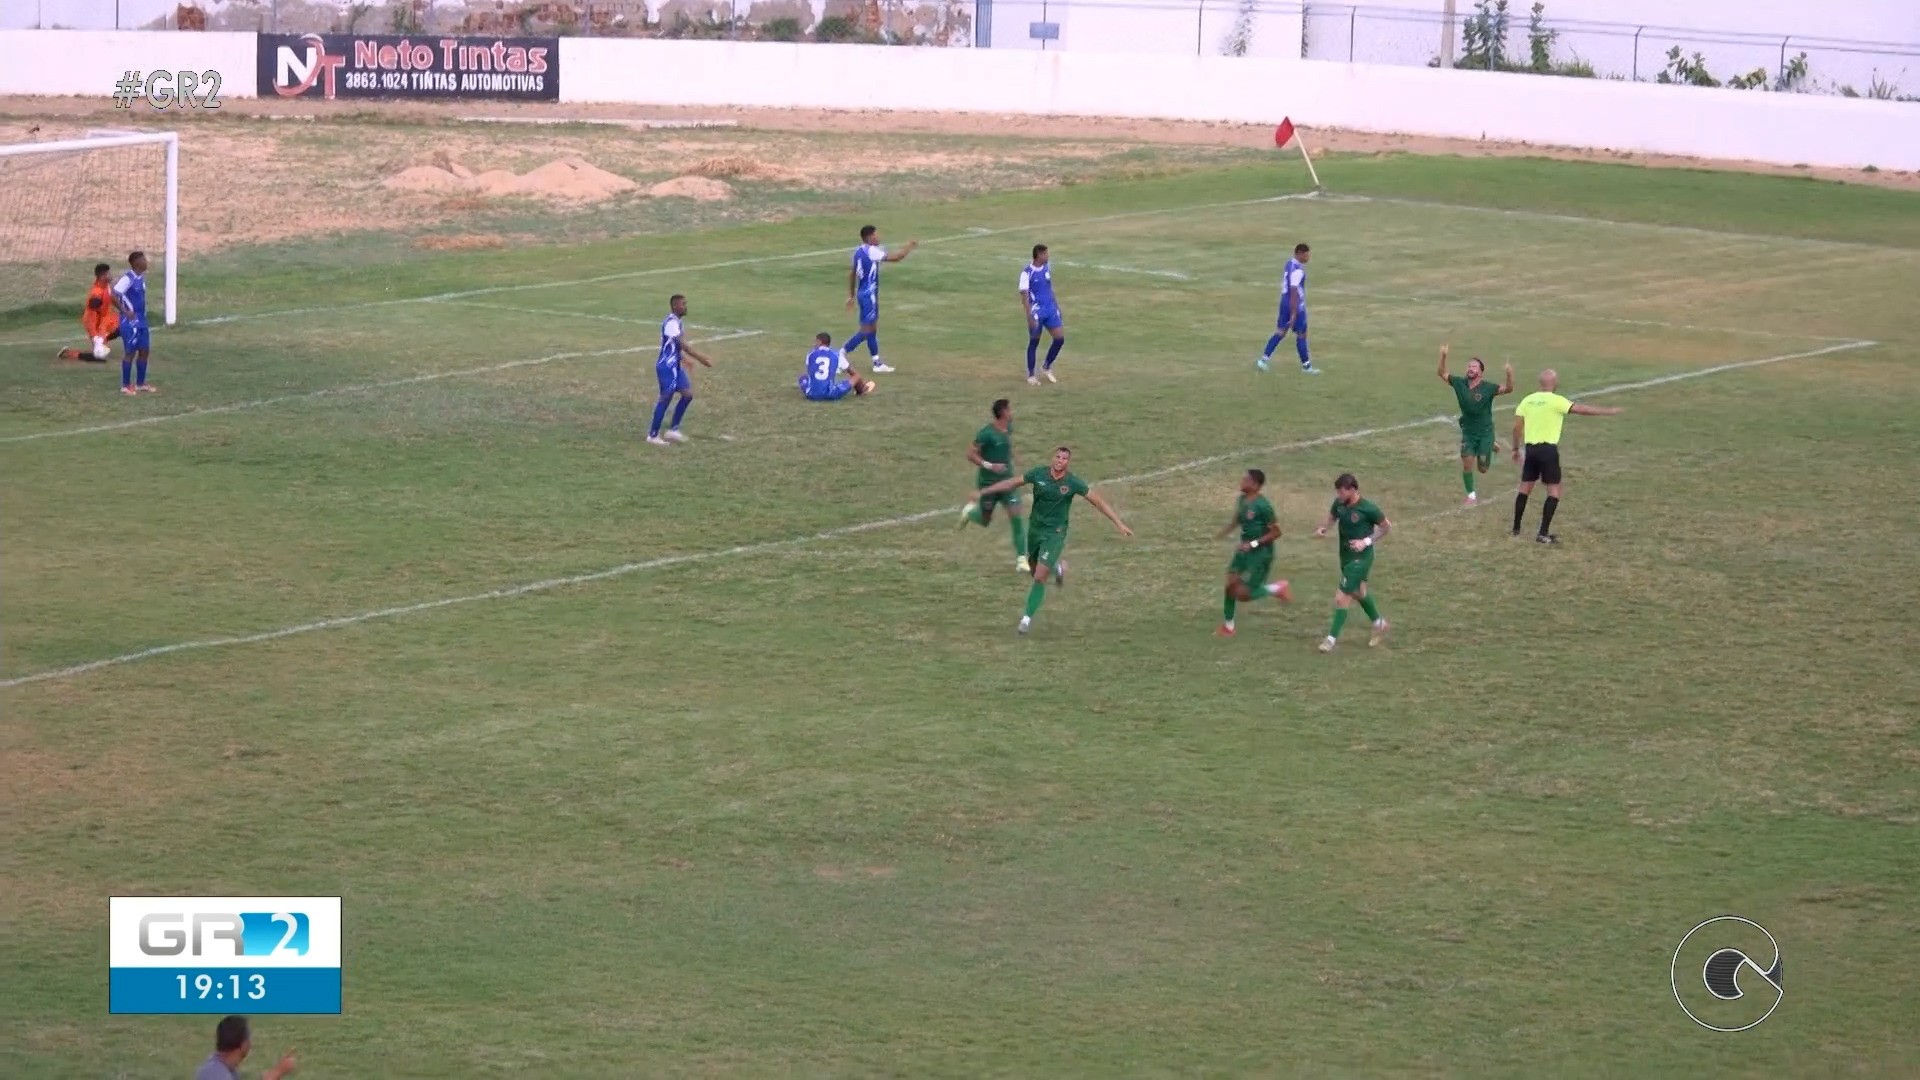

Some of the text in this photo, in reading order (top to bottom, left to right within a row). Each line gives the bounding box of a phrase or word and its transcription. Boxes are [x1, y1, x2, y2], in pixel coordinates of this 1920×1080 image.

[354, 39, 549, 73] Neto Tintas
[460, 73, 545, 92] AUTOMOTIVAS
[814, 357, 831, 380] 3
